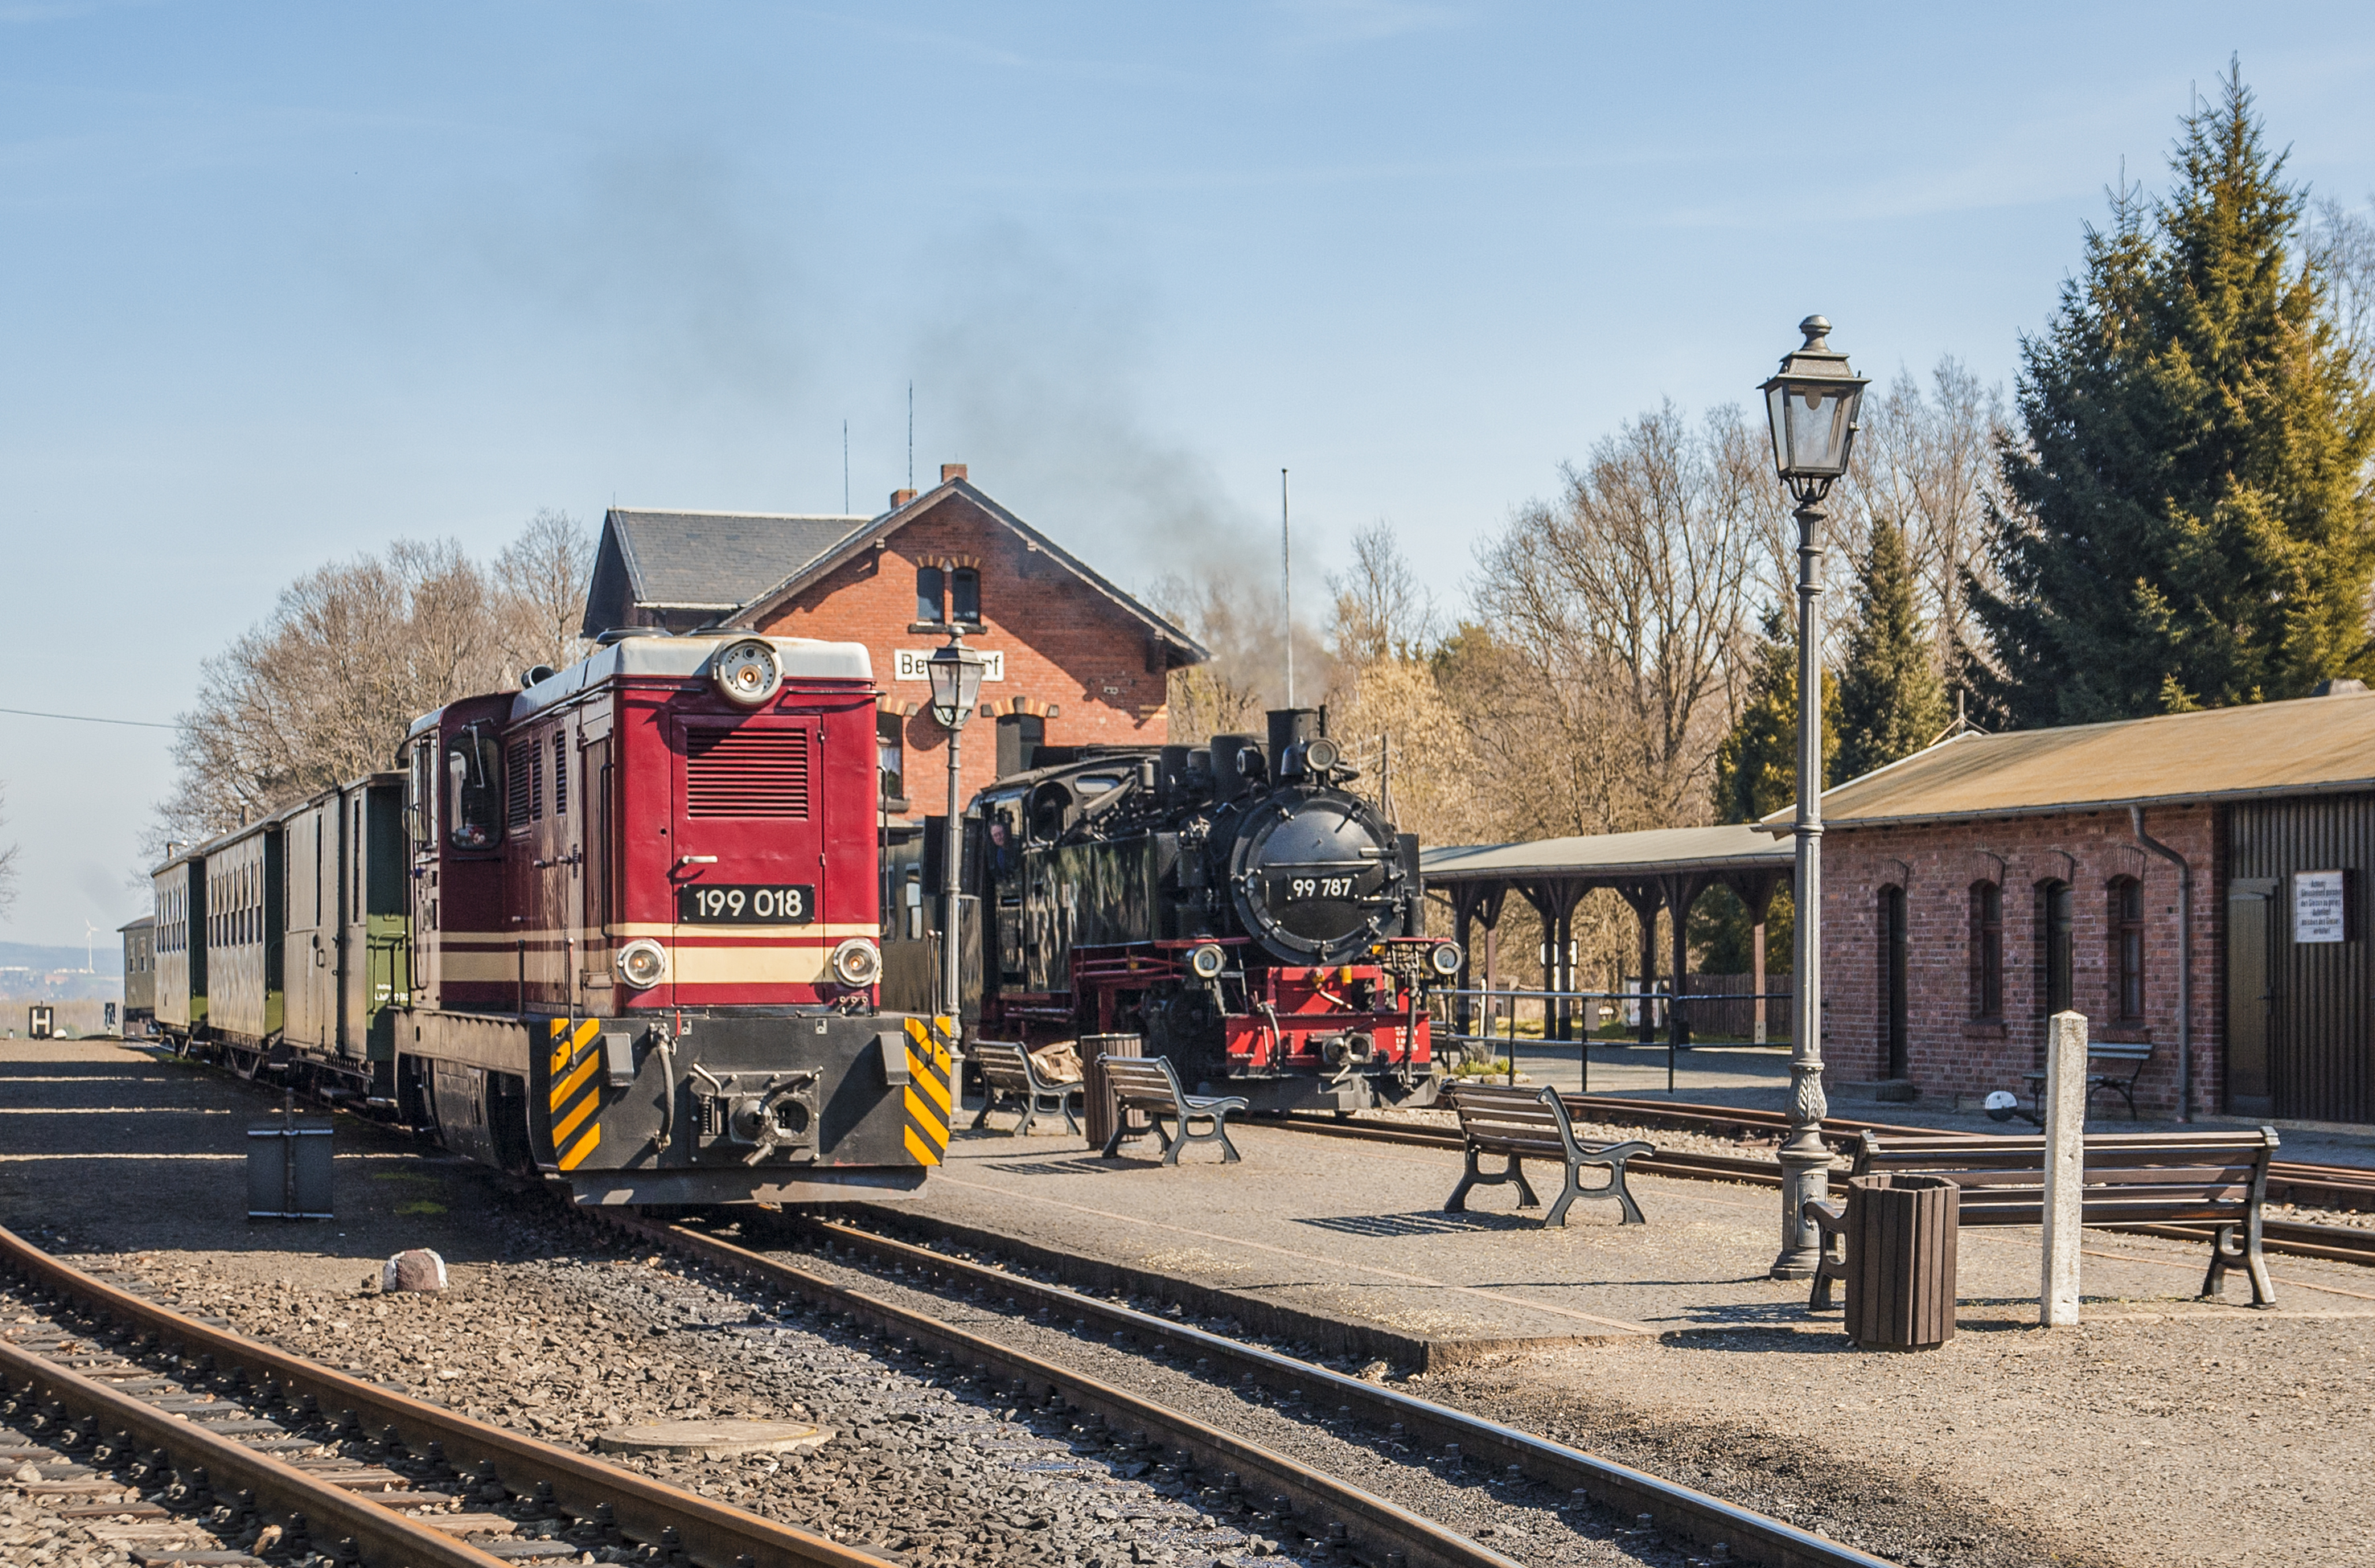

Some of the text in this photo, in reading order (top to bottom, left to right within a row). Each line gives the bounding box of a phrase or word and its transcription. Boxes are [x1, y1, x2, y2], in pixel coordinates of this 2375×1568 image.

[1292, 878, 1352, 897] 99 787
[696, 889, 803, 917] 199 018
[32, 1008, 50, 1035] H
